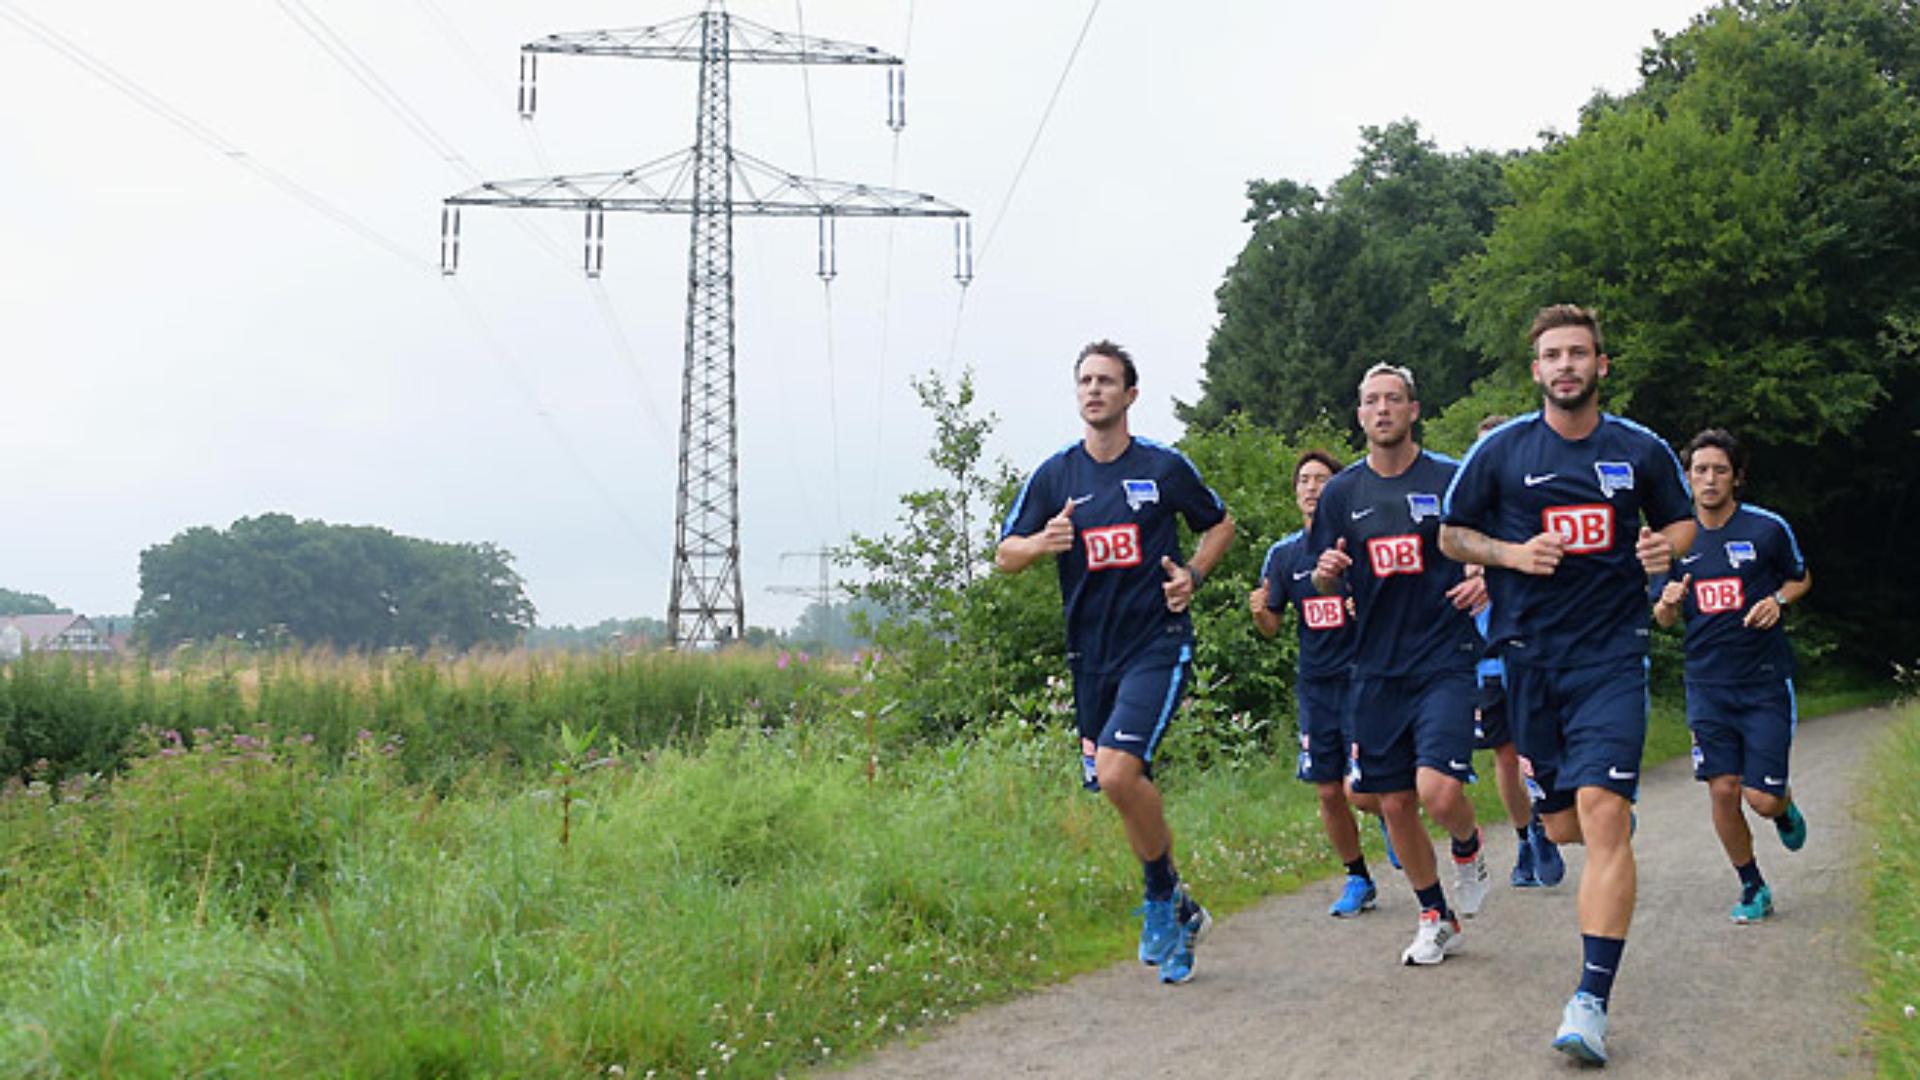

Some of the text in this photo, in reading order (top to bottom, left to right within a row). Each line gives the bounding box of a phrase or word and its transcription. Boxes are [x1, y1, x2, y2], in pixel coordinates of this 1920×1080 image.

[1554, 514, 1605, 545] DB
[1089, 533, 1133, 562] DB
[1375, 542, 1415, 569] DB
[1702, 585, 1736, 608] DB
[1309, 602, 1338, 623] DB
